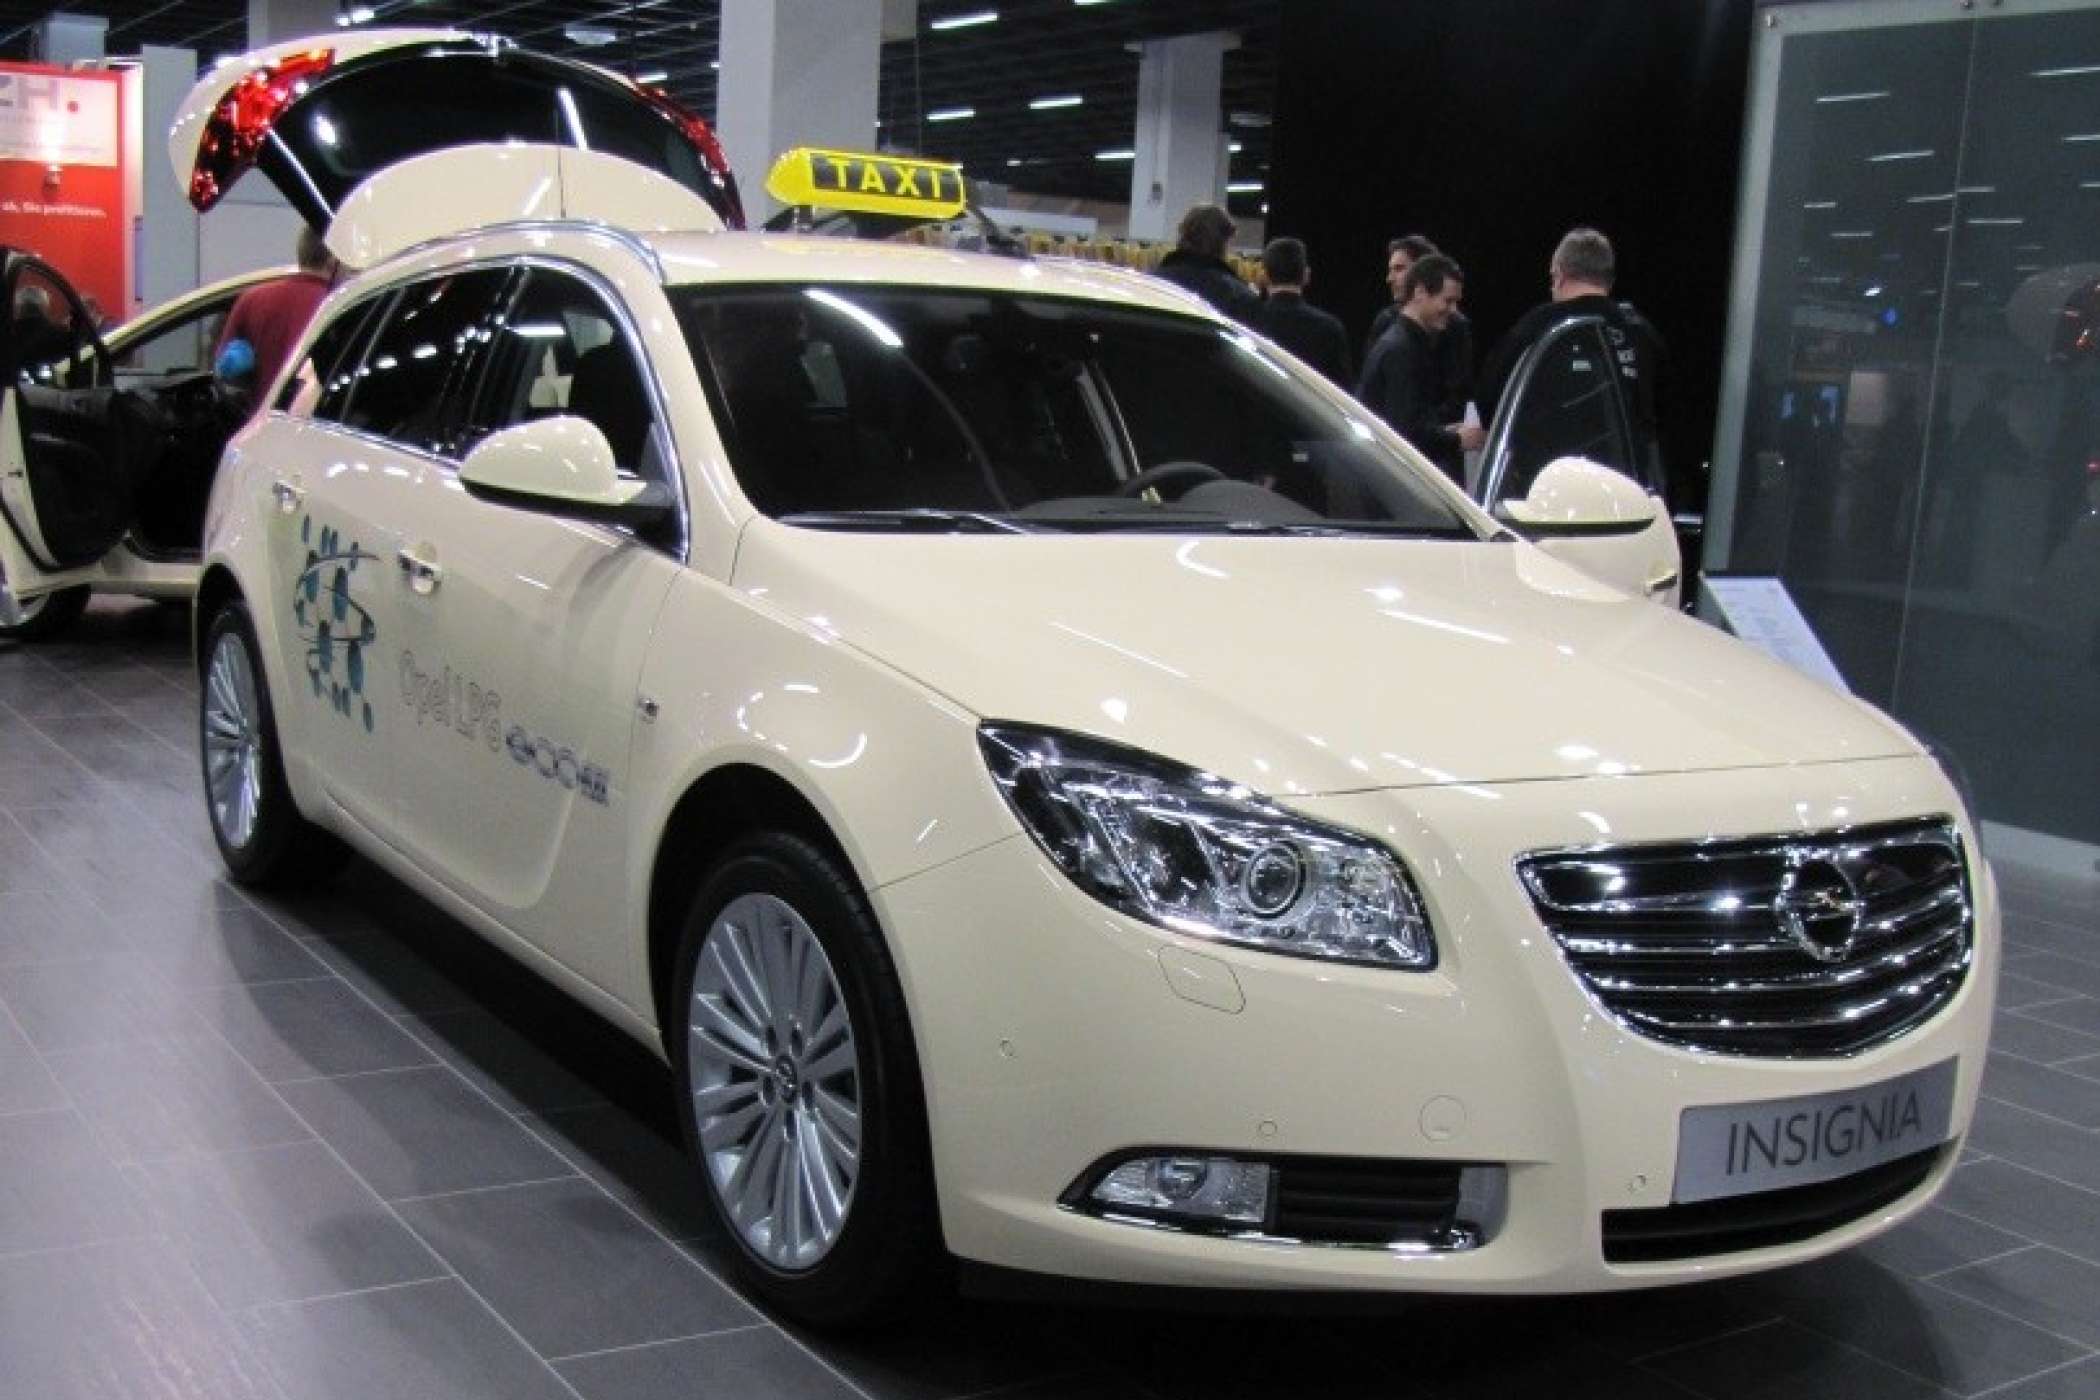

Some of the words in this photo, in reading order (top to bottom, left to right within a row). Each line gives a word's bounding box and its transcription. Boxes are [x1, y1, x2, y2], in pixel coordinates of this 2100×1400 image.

[828, 160, 941, 199] TAXI
[399, 649, 449, 727] Opel
[451, 671, 502, 752] LPG
[1726, 1092, 1922, 1176] INSIGNIA
